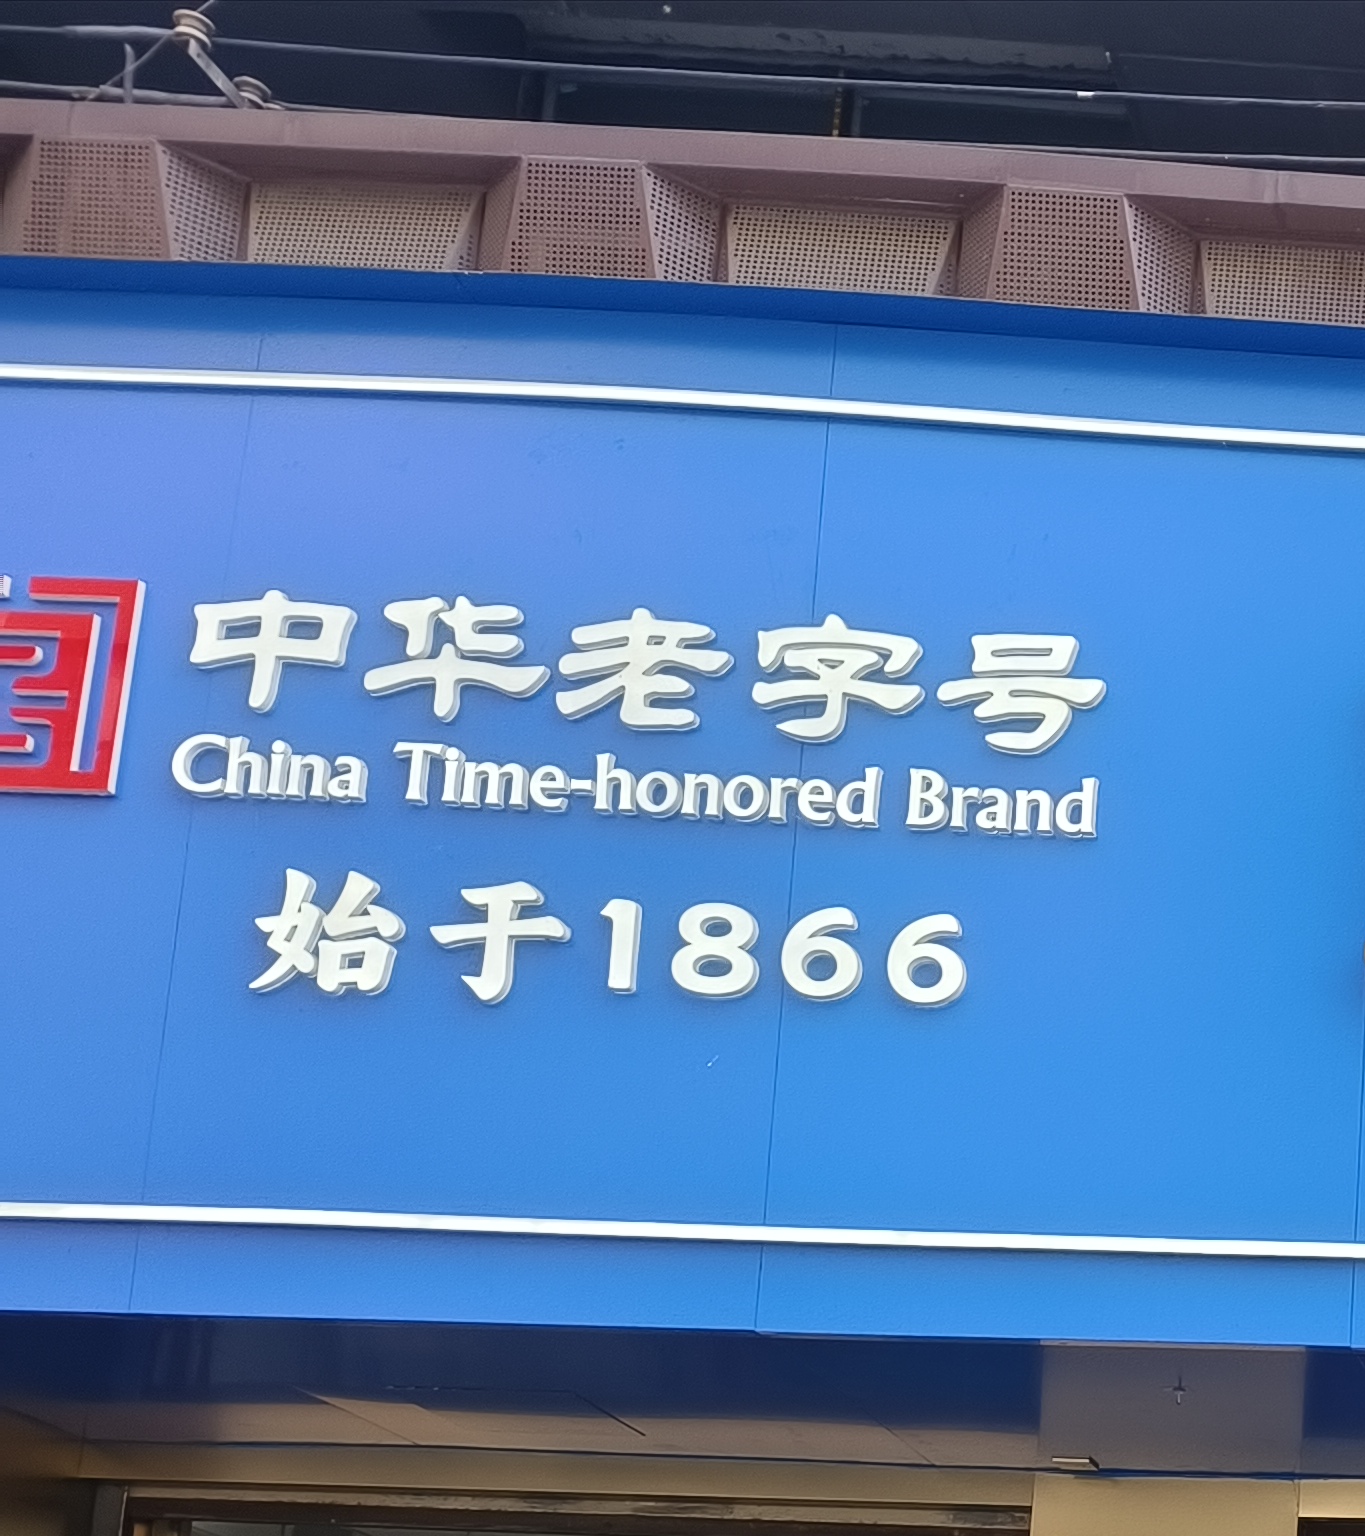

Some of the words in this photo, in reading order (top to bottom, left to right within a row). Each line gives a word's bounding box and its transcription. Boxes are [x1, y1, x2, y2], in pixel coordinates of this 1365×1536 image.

[190, 589, 1107, 756] 中华老字号
[171, 732, 368, 803] China
[394, 741, 884, 829] Time-honored
[906, 767, 1099, 840] Brand
[248, 867, 968, 1008] 始于1866
